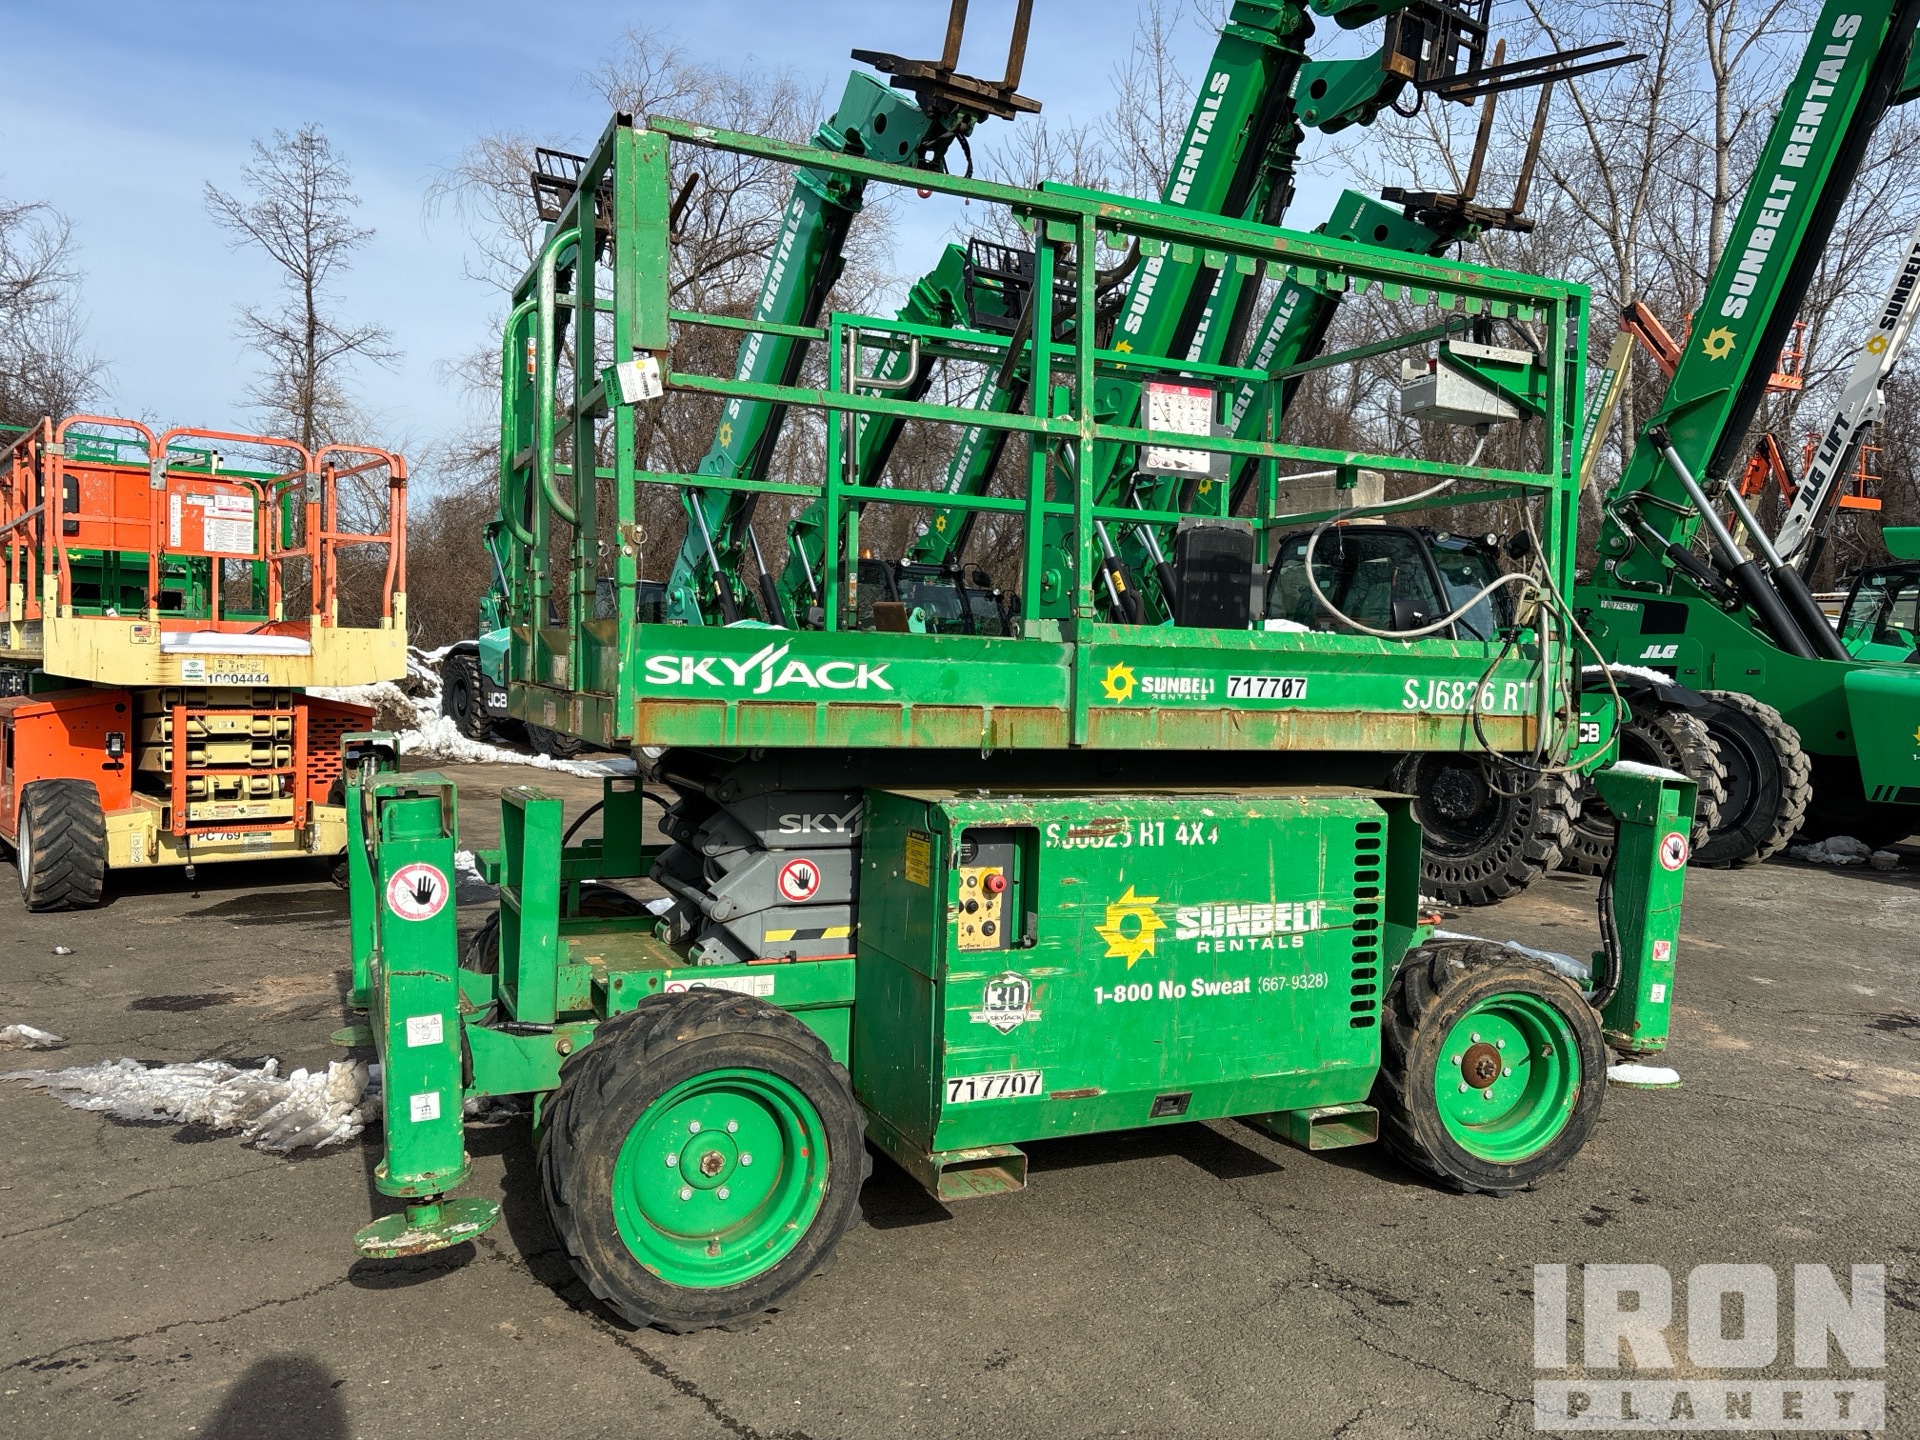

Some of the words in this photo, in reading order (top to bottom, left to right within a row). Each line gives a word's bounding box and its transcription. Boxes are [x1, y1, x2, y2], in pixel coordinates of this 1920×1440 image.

[1170, 72, 1230, 205] RENTALS
[1721, 174, 1797, 319] SUNBELT
[1781, 14, 1862, 168] RENTALS
[762, 197, 806, 313] RENTALS
[610, 370, 618, 390] READY
[614, 392, 620, 401] TO
[1591, 369, 1615, 416] RENTALS
[1800, 467, 1827, 513] JLG
[1818, 411, 1850, 468] LIFT
[1640, 645, 1678, 659] JLG
[208, 673, 270, 685] 10004444
[645, 643, 895, 694] SKYJACK
[488, 692, 508, 708] JCB
[1152, 692, 1207, 701] RENTALS
[1230, 677, 1306, 698] 717707
[1503, 682, 1534, 711] RT
[1579, 723, 1600, 743] CB
[197, 833, 215, 842] PC
[220, 832, 241, 841] 769
[1175, 900, 1327, 940] SUNBELT
[1196, 936, 1304, 954] RENTALS
[990, 982, 1025, 1010] 30
[1094, 982, 1153, 1004] 1-800
[1158, 980, 1187, 1000] No
[1191, 976, 1251, 998] Sweat
[1258, 971, 1329, 994] (667-9328)
[990, 1013, 1022, 1021] SKYJACK
[948, 1073, 1040, 1102] 717707
